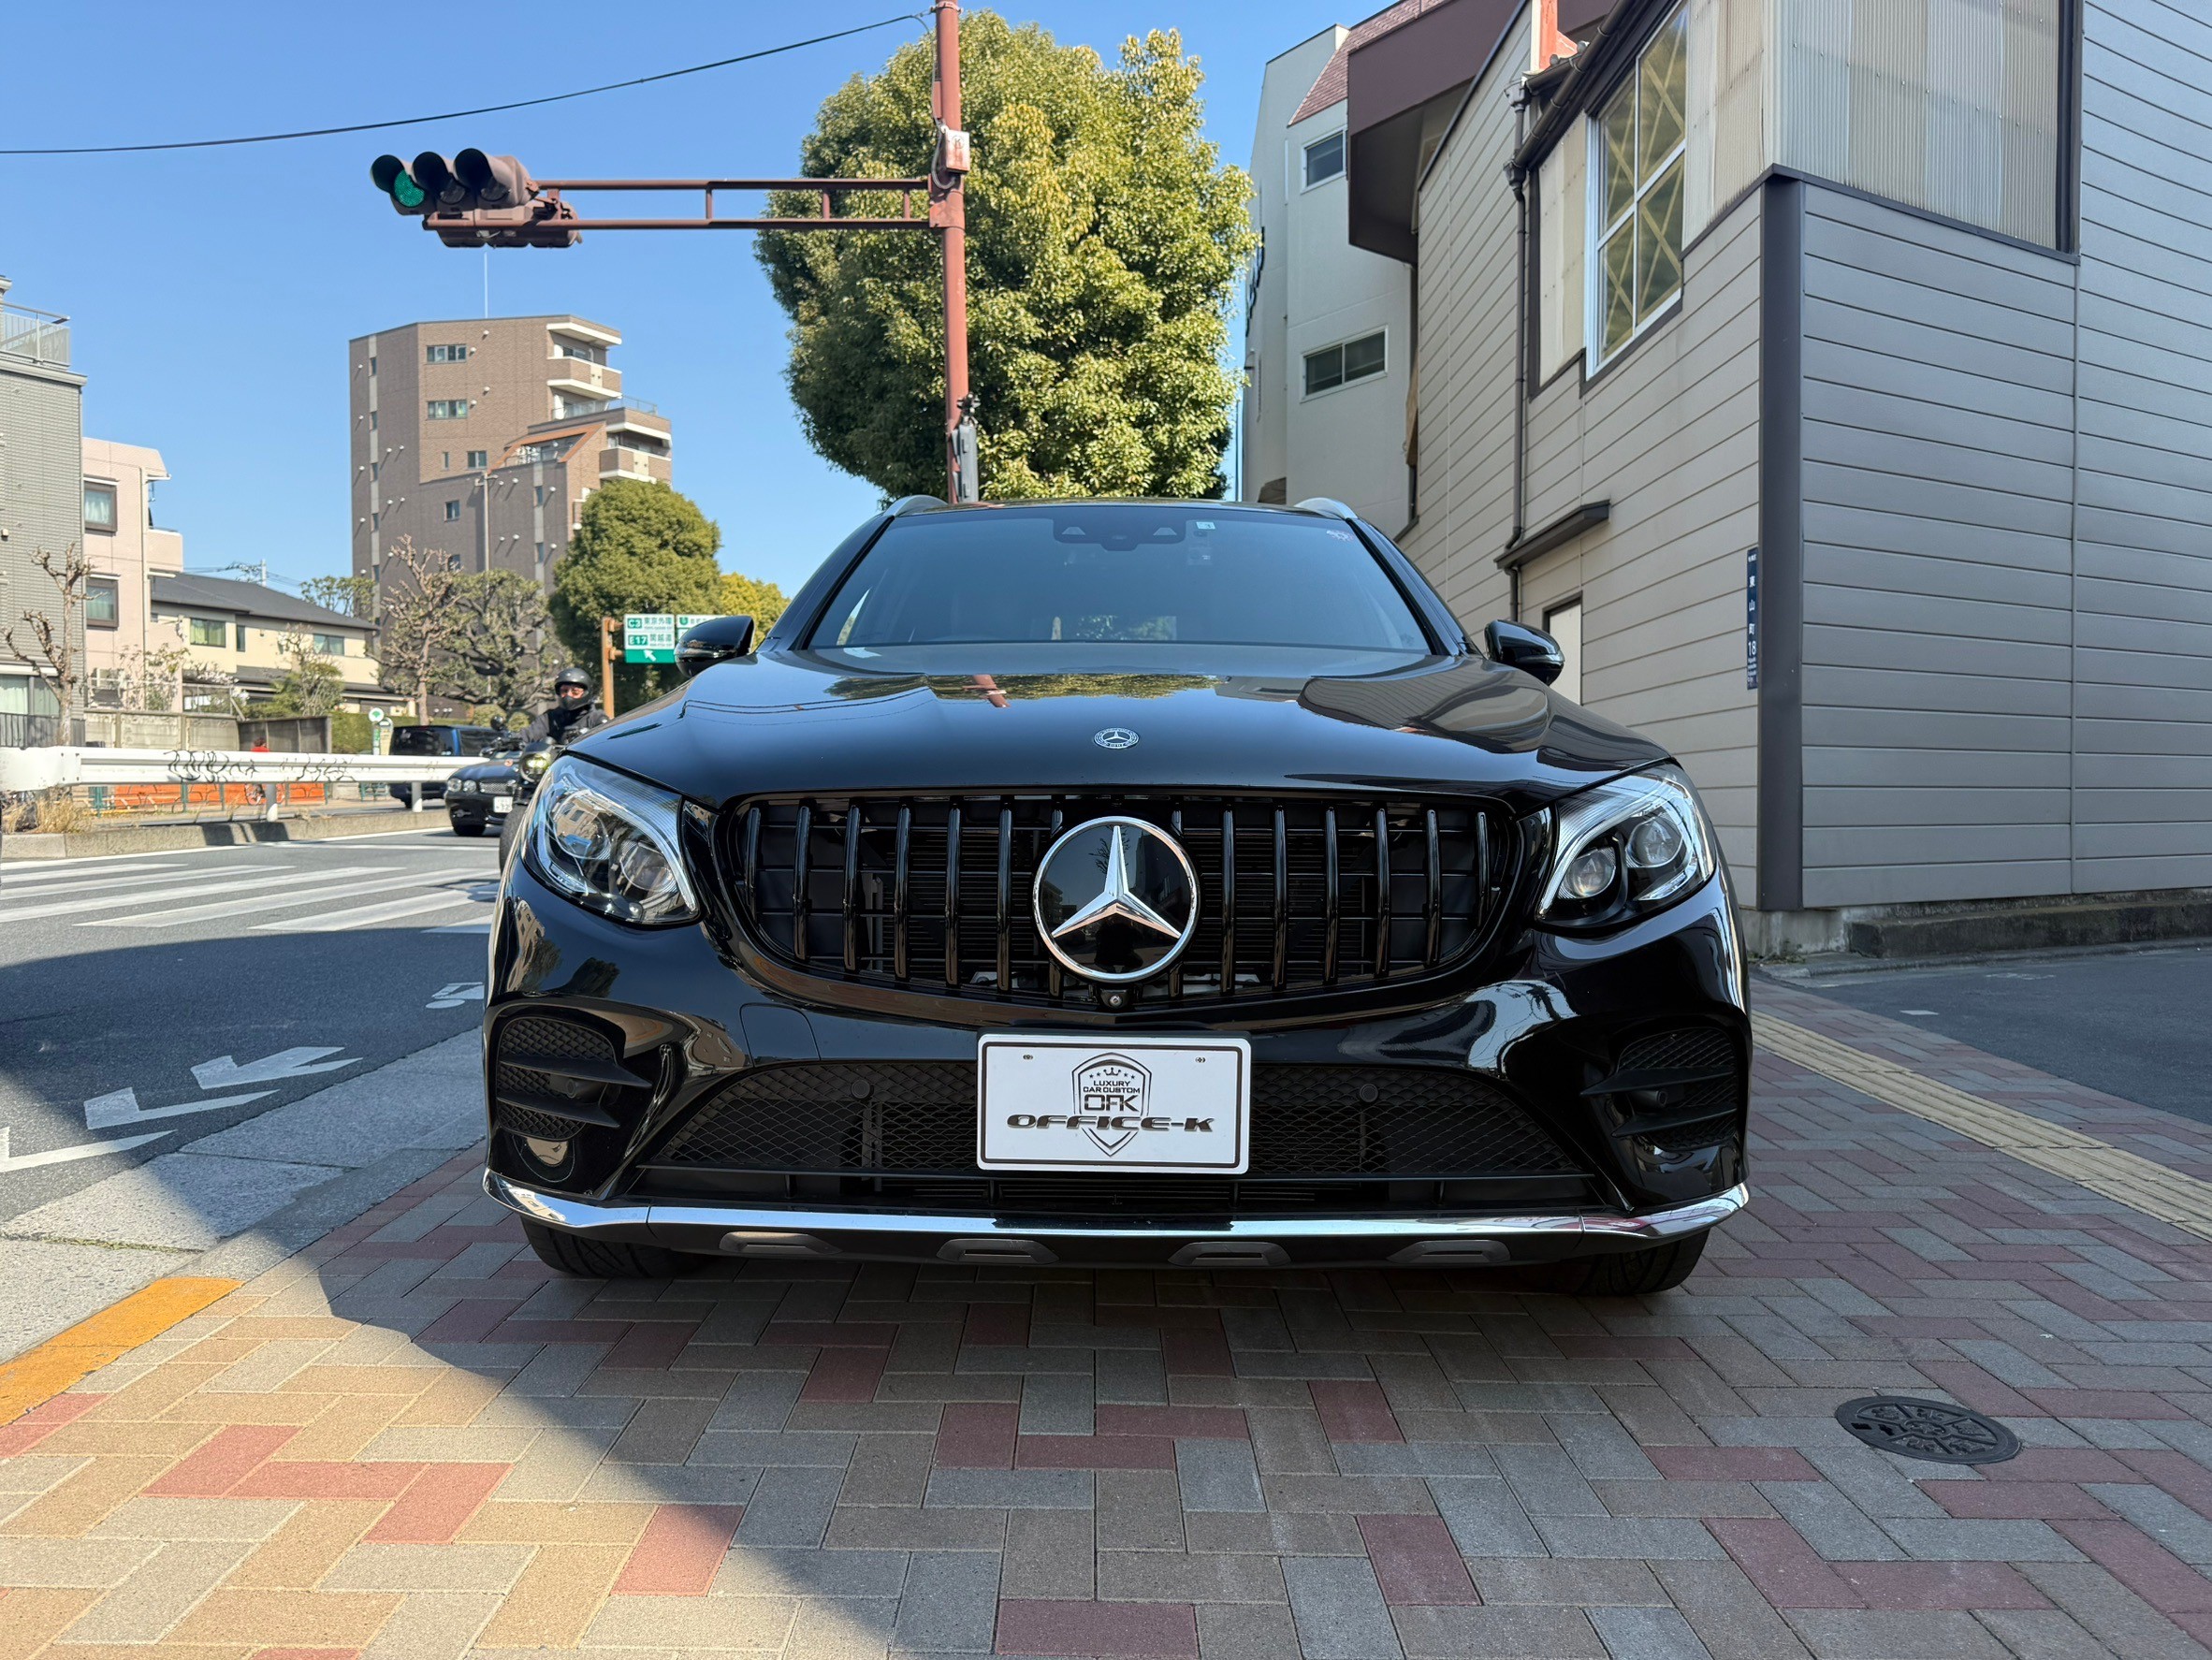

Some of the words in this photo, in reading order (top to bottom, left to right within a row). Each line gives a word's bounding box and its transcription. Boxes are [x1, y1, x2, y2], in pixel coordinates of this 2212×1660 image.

[629, 619, 642, 628] C3
[629, 636, 647, 645] E17
[1748, 641, 1756, 656] 18
[1007, 1114, 1215, 1132] OFFICE-K
